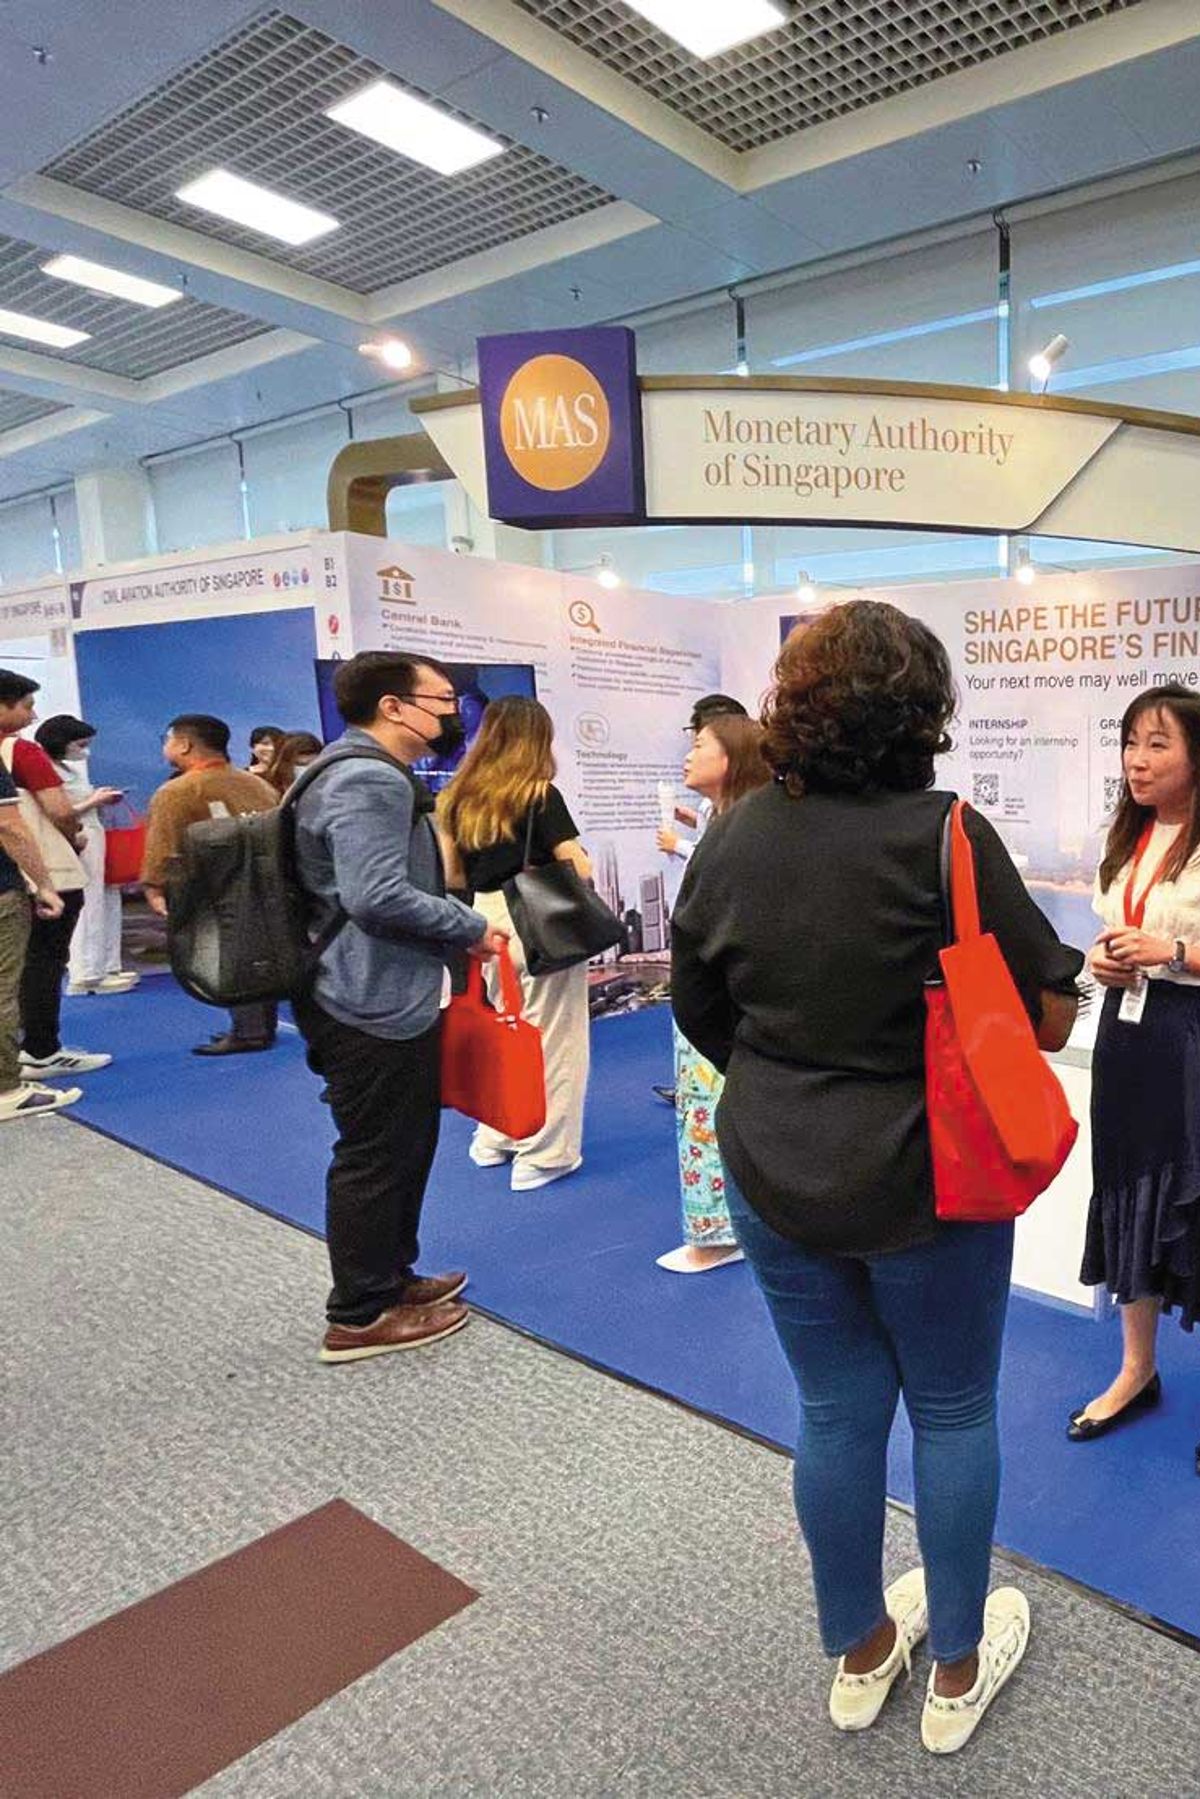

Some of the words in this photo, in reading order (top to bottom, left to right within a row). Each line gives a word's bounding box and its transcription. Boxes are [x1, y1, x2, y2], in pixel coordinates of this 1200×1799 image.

[513, 392, 599, 450] MAS
[704, 409, 863, 455] Monetary
[864, 415, 1015, 465] Authority
[704, 454, 735, 488] of
[742, 454, 906, 498] Singapore
[154, 578, 197, 599] AUTHORITY
[199, 576, 211, 593] OF
[212, 568, 264, 591] SINGAPORE
[381, 609, 428, 624] Central
[430, 615, 463, 629] Bank
[964, 607, 1049, 634] SHAPE
[1055, 603, 1107, 629] THE
[569, 634, 617, 650] Integrated
[617, 639, 658, 653] Financial
[964, 633, 1143, 665] SINGAPORE'S
[965, 674, 996, 690] Your
[1000, 674, 1030, 688] next
[1034, 675, 1075, 688] move
[1079, 674, 1112, 691] may
[1113, 669, 1148, 688] well
[1152, 671, 1199, 686] move
[968, 718, 1029, 731] INTERNSHIP
[1099, 718, 1123, 731] GRA
[969, 736, 1005, 748] Looking
[1005, 736, 1019, 746] for
[1019, 738, 1032, 746] an
[1033, 736, 1079, 748] internship
[1099, 736, 1119, 748] Gra
[576, 750, 628, 761] Technology
[969, 750, 1024, 761] opportunity?
